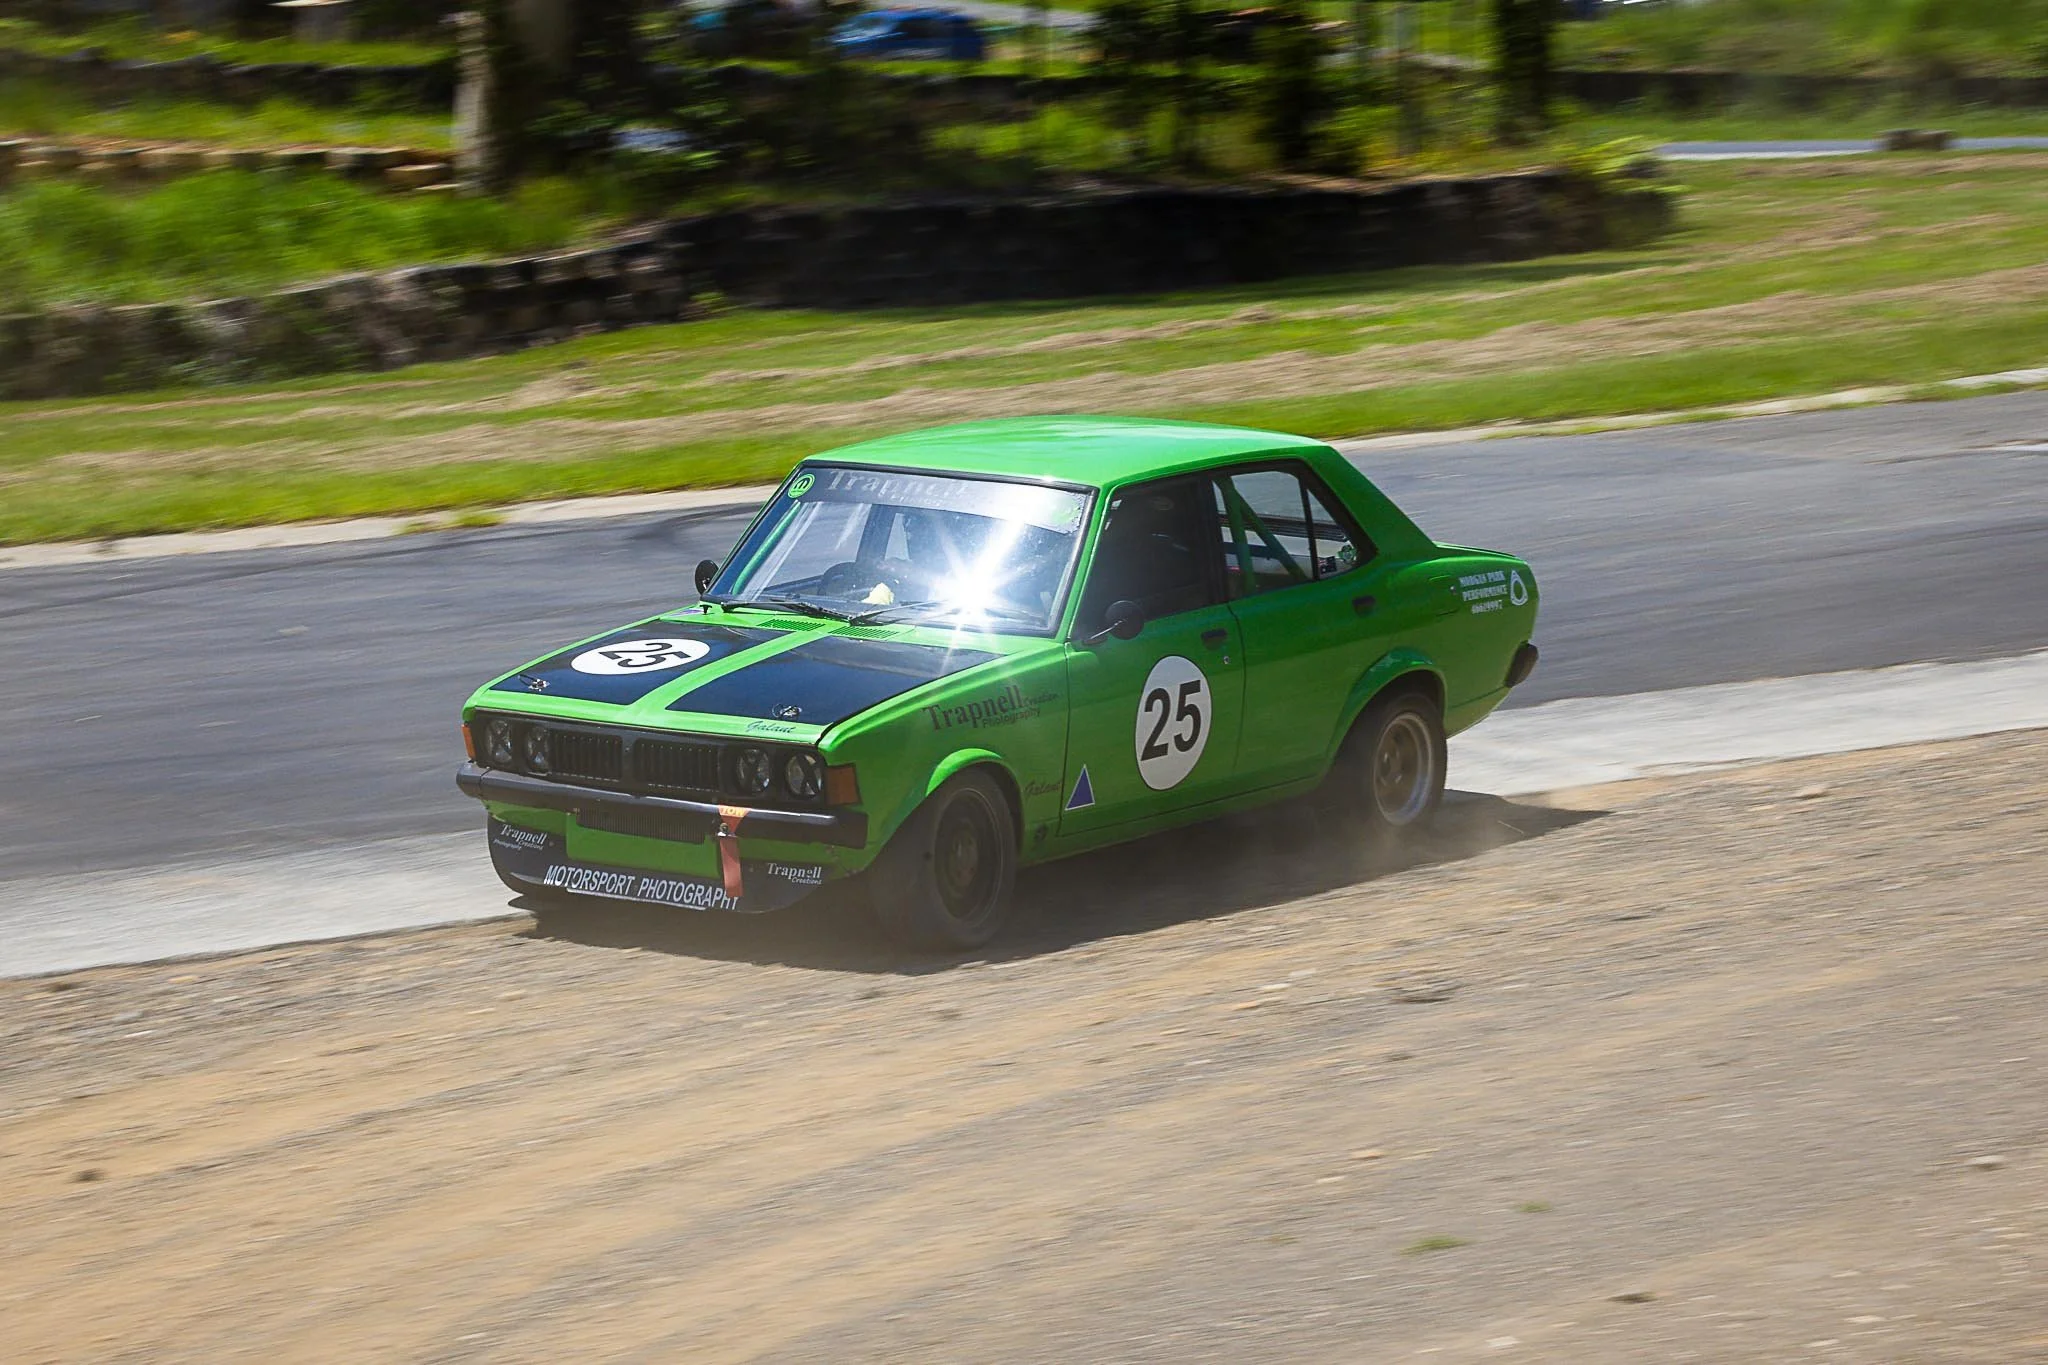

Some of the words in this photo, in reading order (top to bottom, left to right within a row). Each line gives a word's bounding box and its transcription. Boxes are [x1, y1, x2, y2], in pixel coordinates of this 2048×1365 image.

[598, 642, 692, 668] 25
[921, 685, 1023, 730] Trapnell
[745, 719, 795, 734] Galant
[1140, 679, 1201, 761] 25
[720, 806, 746, 818] TOW
[500, 823, 548, 845] Trapnell
[543, 865, 636, 896] MOTORSPORT
[767, 862, 822, 880] Trapnell
